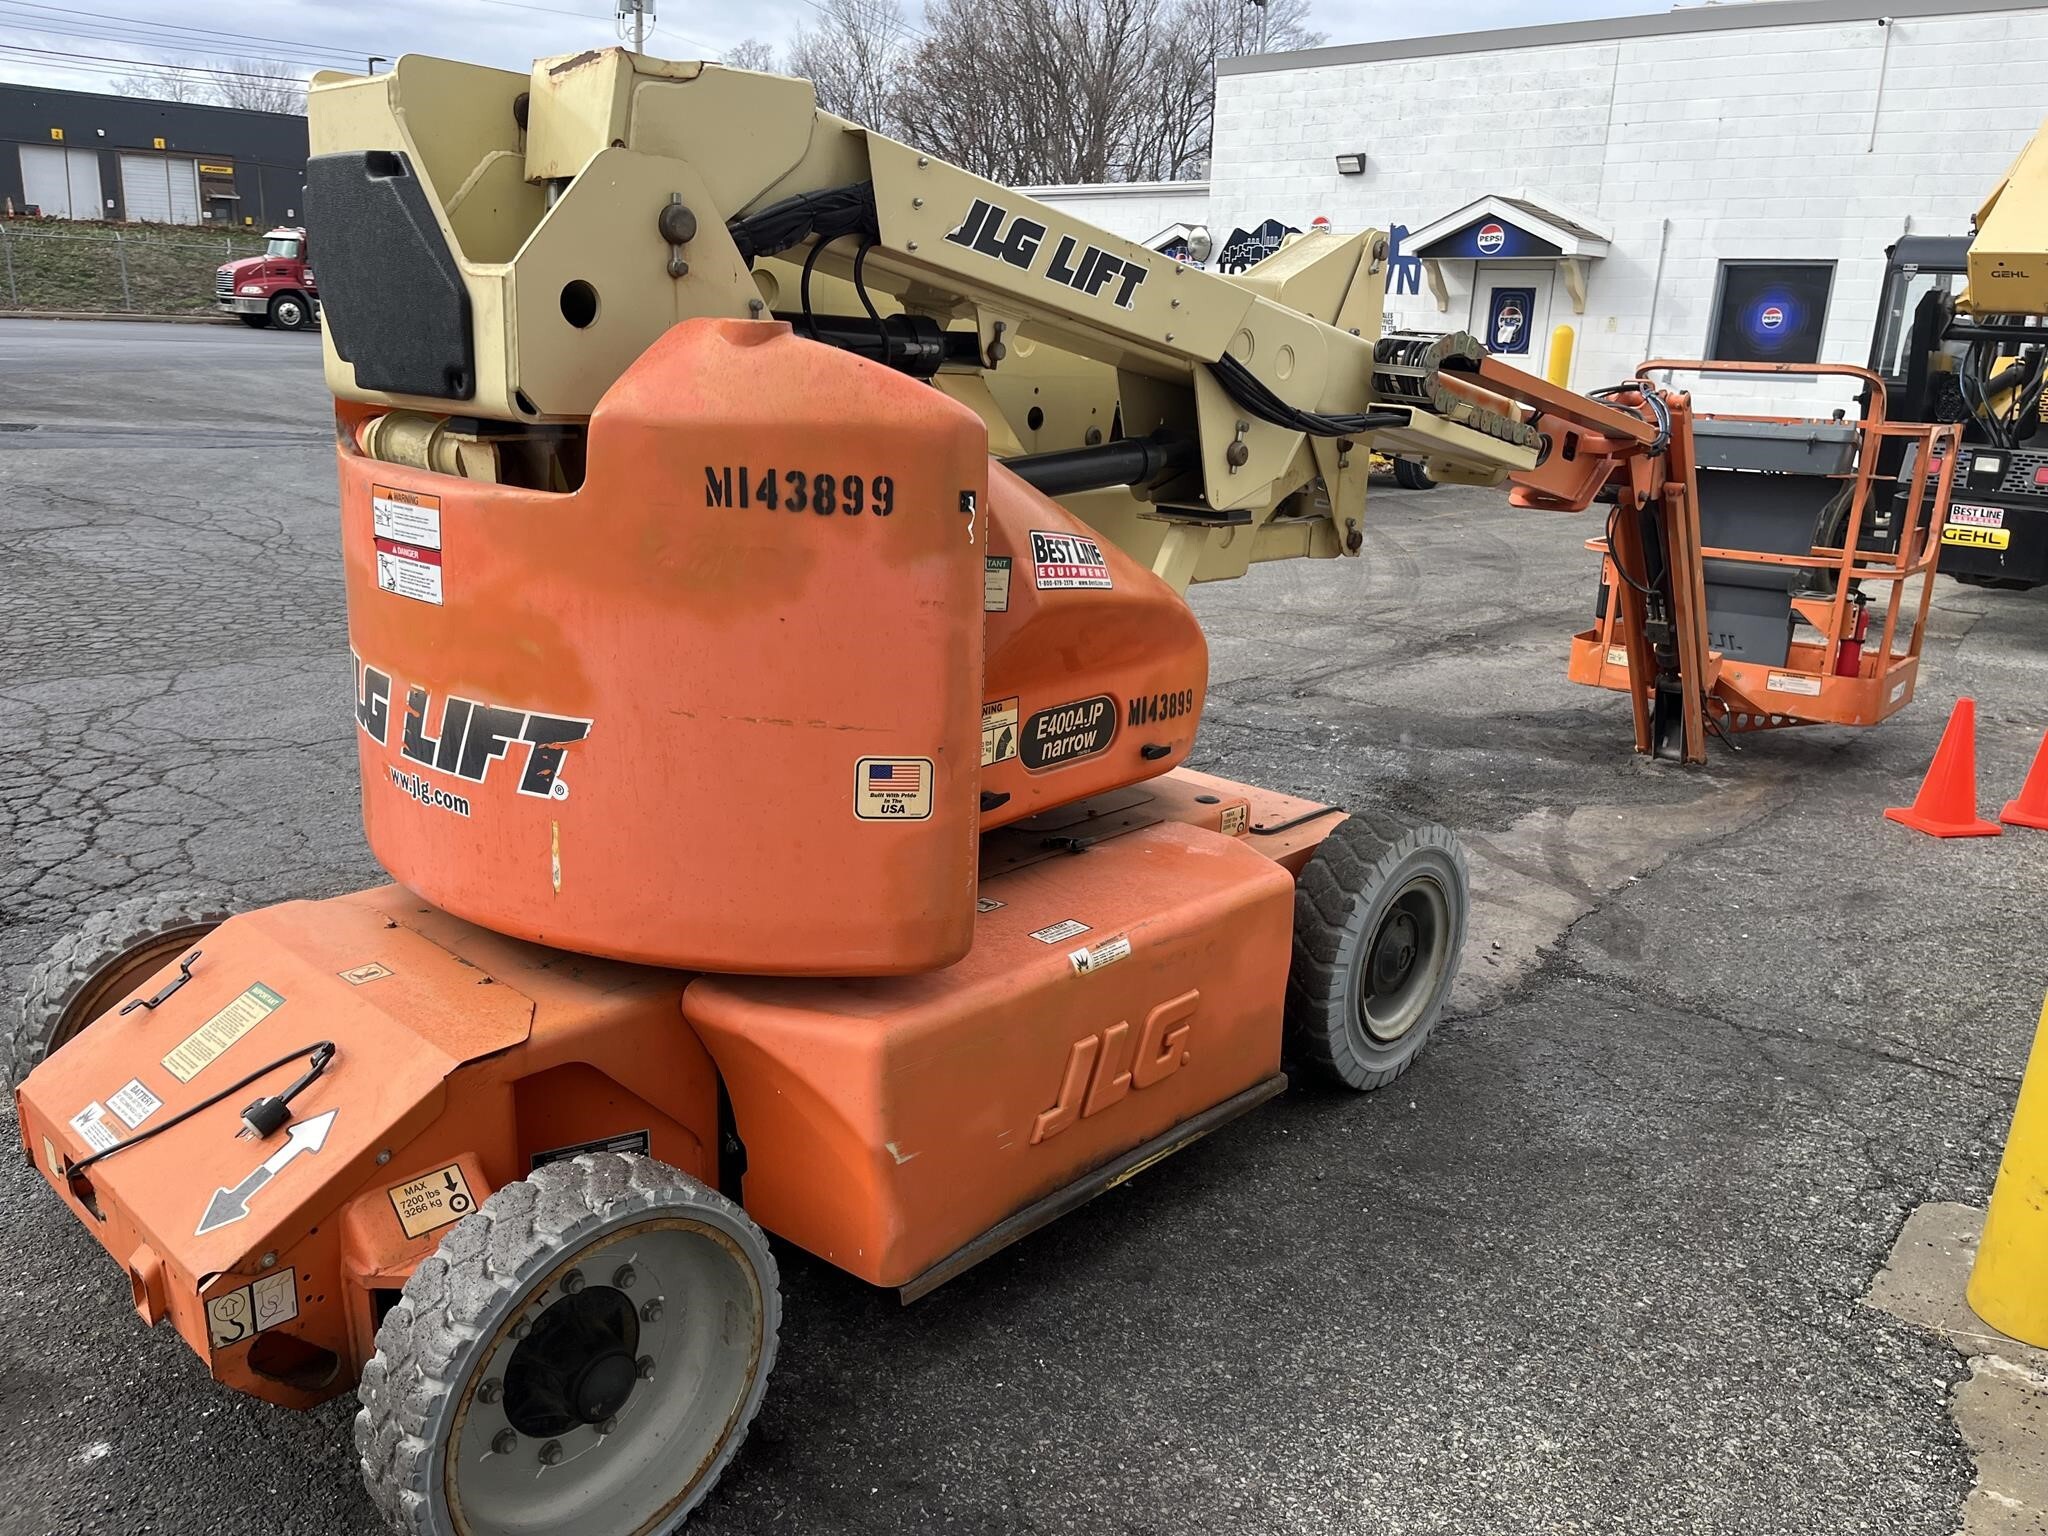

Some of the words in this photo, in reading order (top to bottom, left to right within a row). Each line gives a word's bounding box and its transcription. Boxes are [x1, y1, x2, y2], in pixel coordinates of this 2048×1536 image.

[1480, 234, 1503, 243] PEPSI
[945, 199, 1047, 270] JLG
[1045, 235, 1149, 309] LIFT
[1500, 316, 1521, 325] PEPSI
[393, 492, 419, 506] WARNING
[1953, 506, 1977, 517] BEST
[1980, 509, 2002, 519] LINE
[1943, 528, 2002, 545] GEHL
[397, 546, 419, 560] DANGER
[1033, 534, 1073, 564] BEST
[1070, 537, 1105, 566] LINE
[1039, 566, 1108, 577] EQUIPMENT
[349, 650, 393, 745] LG
[402, 686, 591, 797] LIFT
[1041, 730, 1098, 761] narrow
[390, 765, 470, 816] ww.jlg.com
[881, 805, 906, 814] USA
[1030, 988, 1200, 1145] JLG
[130, 1084, 156, 1107] BATTERY
[404, 1181, 428, 1197] MAX
[400, 1194, 424, 1209] 7200
[425, 1189, 440, 1199] lbs
[404, 1203, 428, 1218] 3266
[429, 1198, 443, 1208] kg
